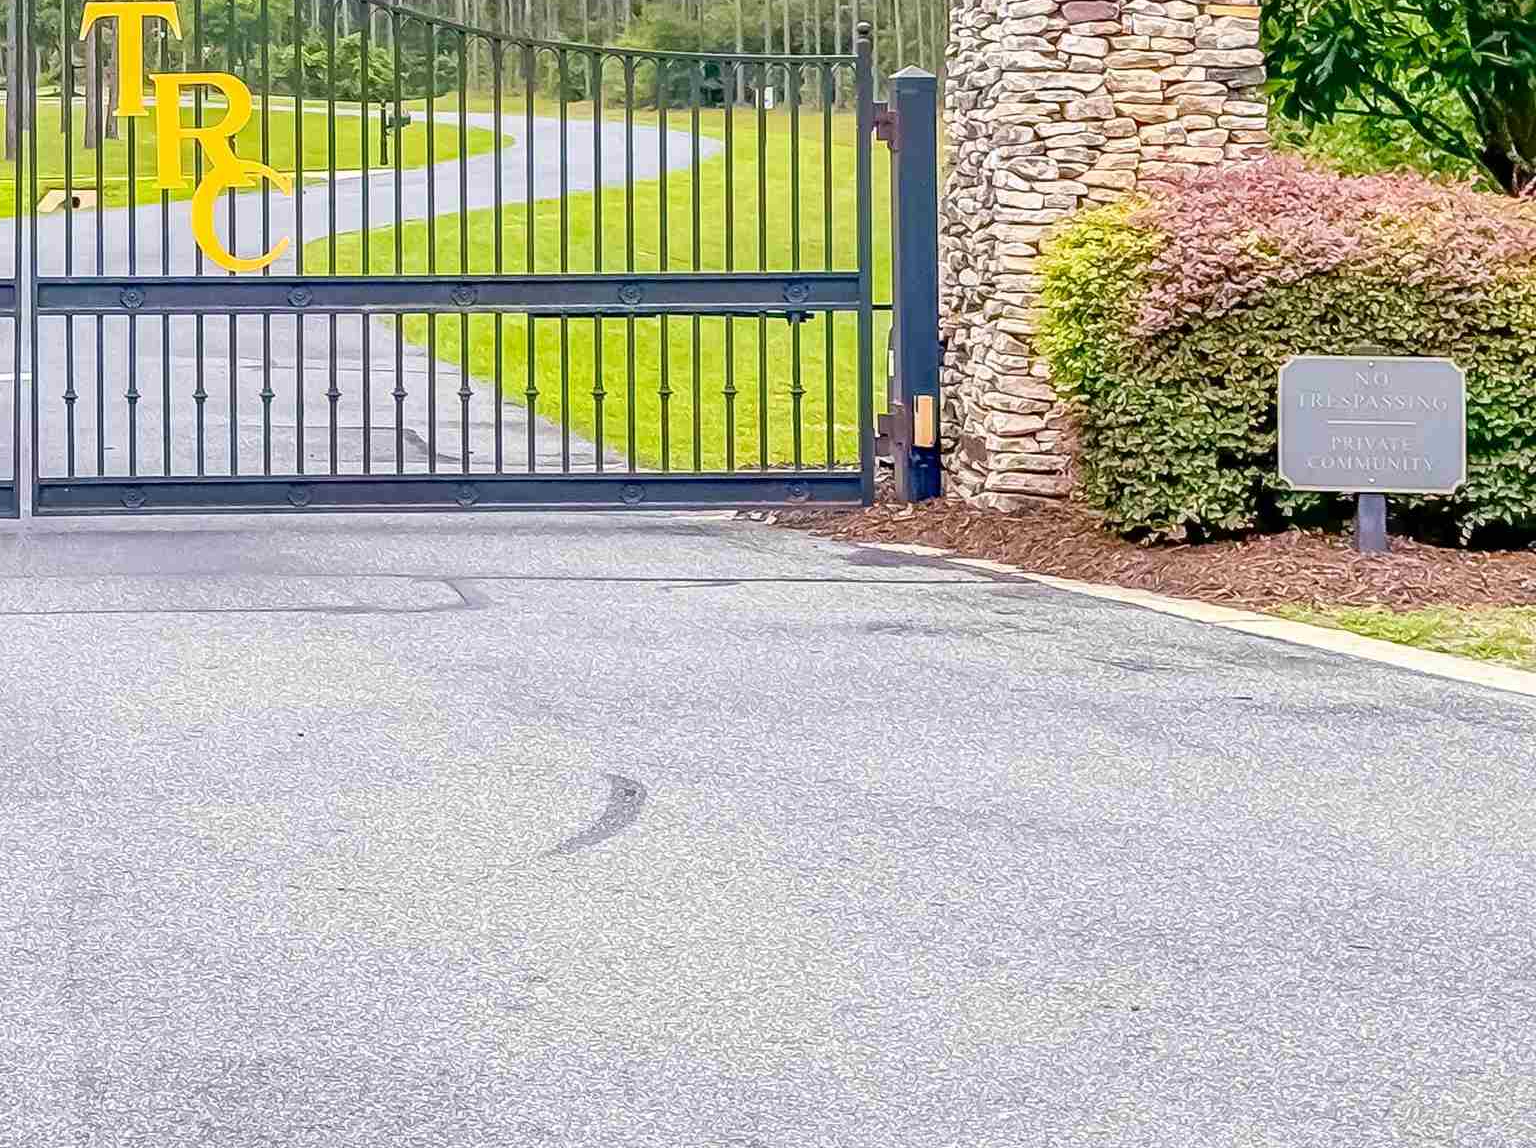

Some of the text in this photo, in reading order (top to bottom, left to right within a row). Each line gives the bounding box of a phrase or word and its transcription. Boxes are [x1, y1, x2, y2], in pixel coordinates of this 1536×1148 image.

[1354, 371, 1390, 386] NO
[1297, 392, 1448, 412] TRESPASSING
[1331, 435, 1413, 452] PRIVATE
[1307, 455, 1434, 471] COMMUNITY
